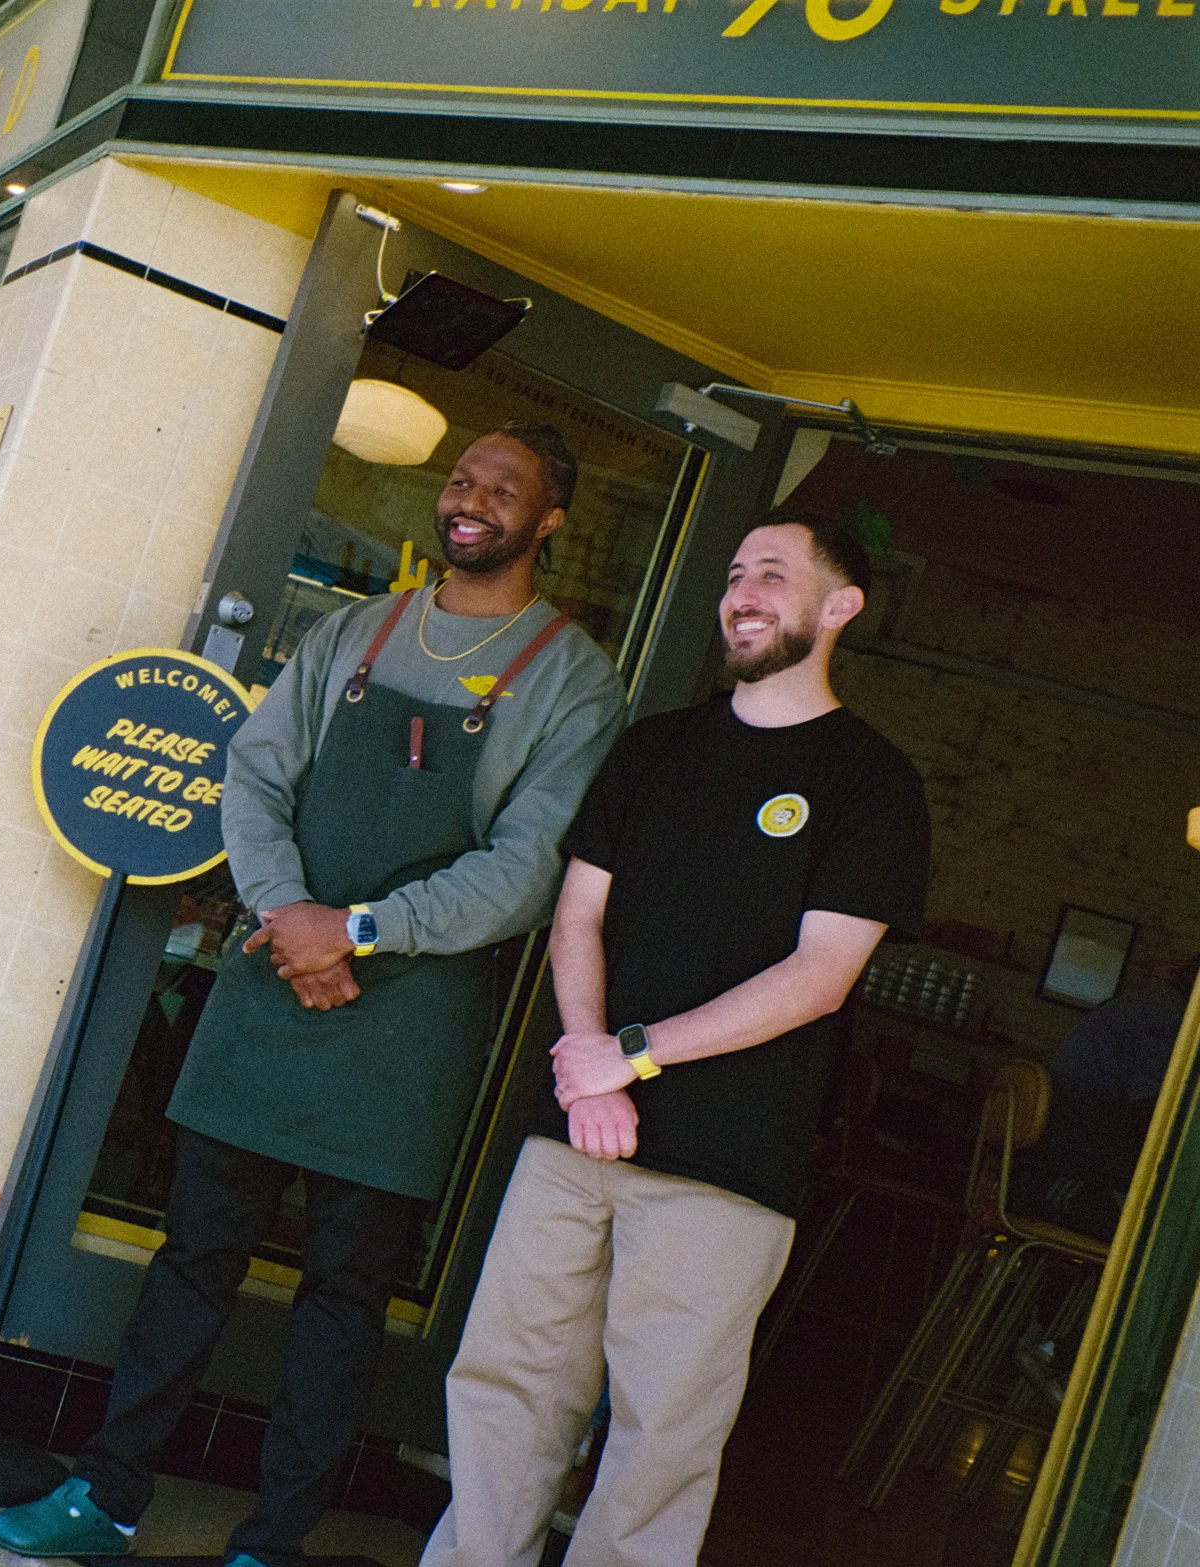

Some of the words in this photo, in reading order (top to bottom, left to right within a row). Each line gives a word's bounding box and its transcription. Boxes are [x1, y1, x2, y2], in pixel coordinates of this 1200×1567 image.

[115, 668, 237, 723] WELCOME!
[106, 718, 216, 765] PLEASE
[72, 745, 149, 781] WAIT
[144, 765, 184, 792] TO
[182, 777, 224, 804] BE
[83, 785, 193, 833] SEATED
